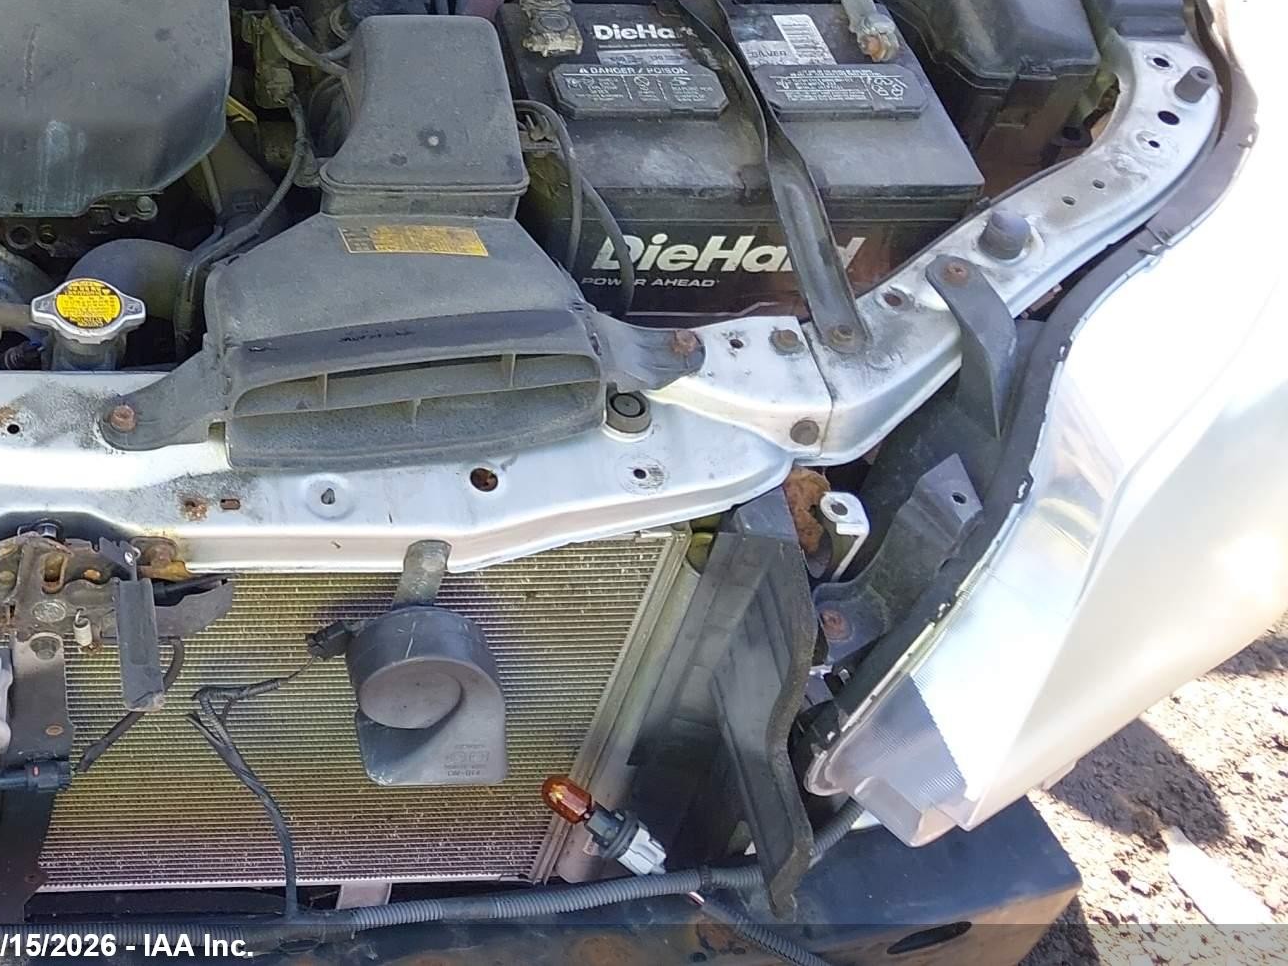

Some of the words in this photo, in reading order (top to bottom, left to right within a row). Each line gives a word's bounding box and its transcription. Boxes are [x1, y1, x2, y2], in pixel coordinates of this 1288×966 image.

[593, 23, 697, 40] DieHa
[592, 233, 866, 273] DieHad
[581, 277, 647, 286] POWR
[651, 278, 715, 287] AHEAD
